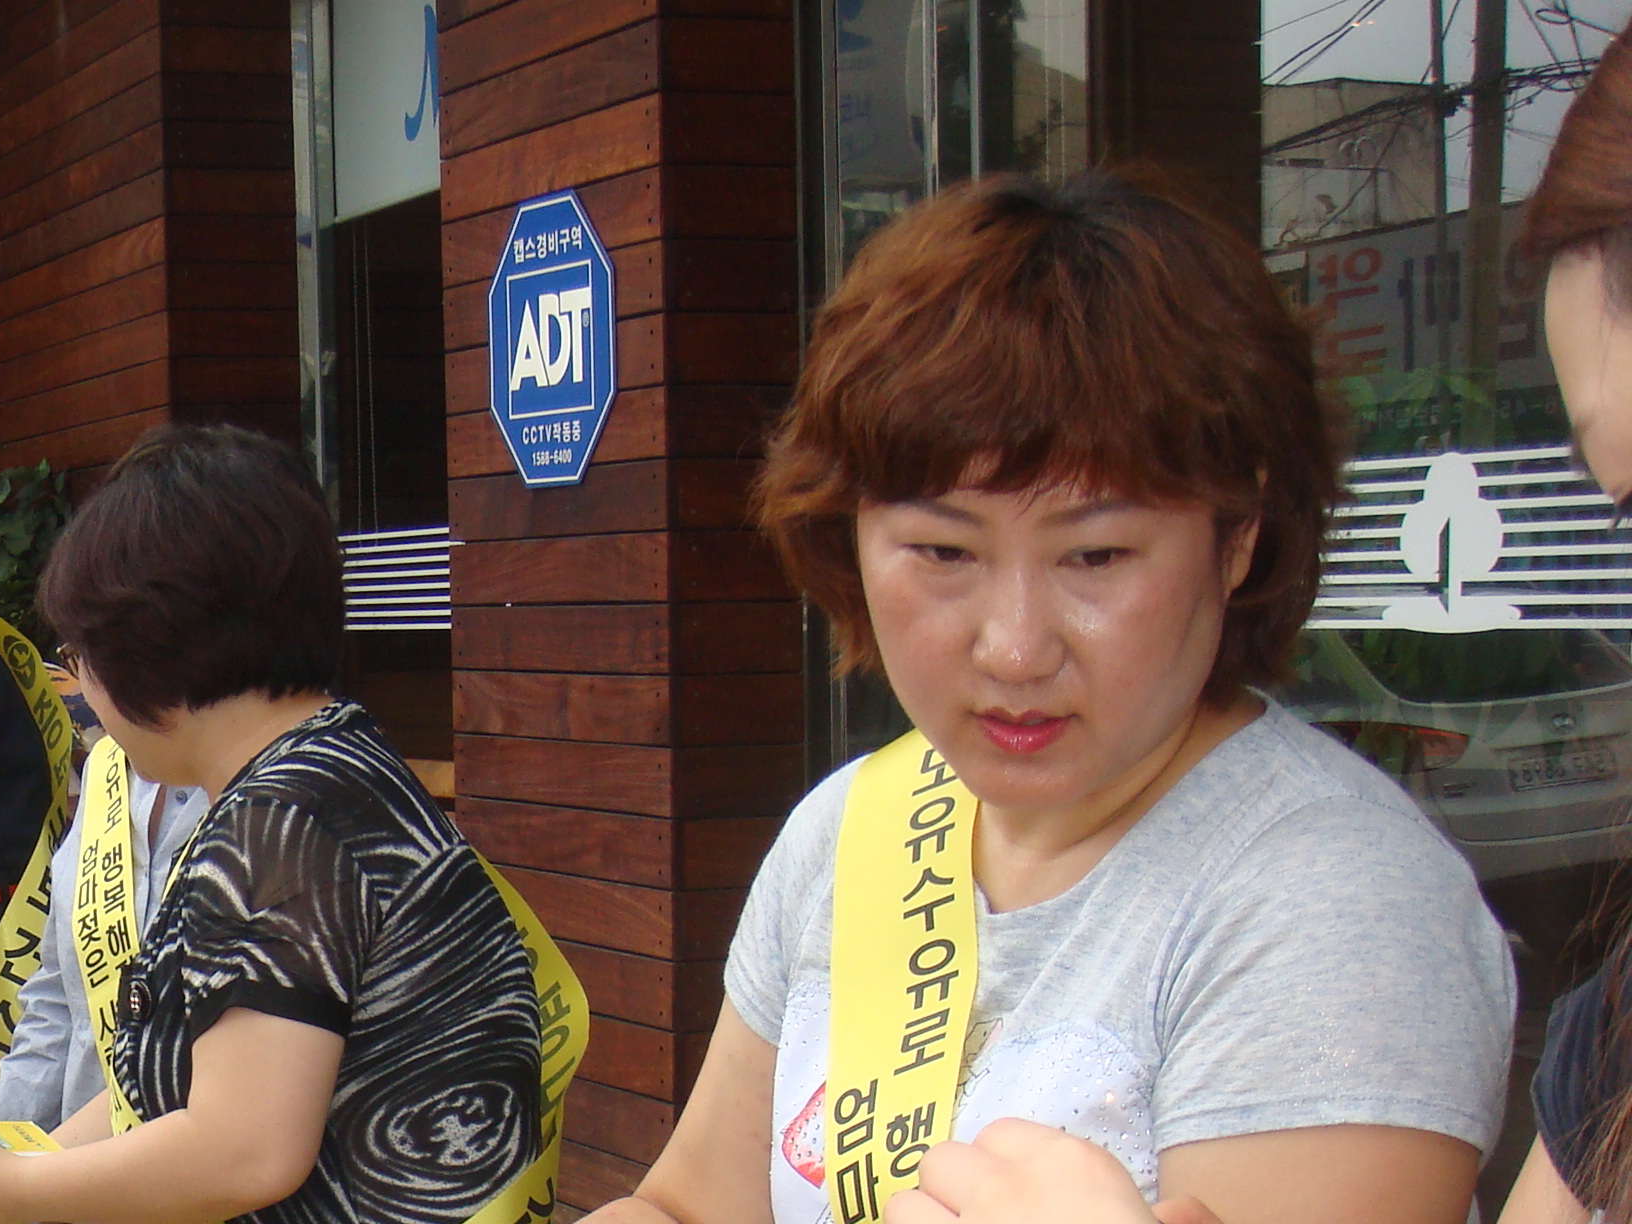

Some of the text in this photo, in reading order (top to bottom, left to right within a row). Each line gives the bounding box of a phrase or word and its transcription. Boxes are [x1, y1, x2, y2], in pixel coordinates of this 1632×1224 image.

[513, 224, 582, 264] 캡스경비구역
[511, 287, 591, 391] ADT
[522, 419, 582, 446] CCTV작동중
[531, 447, 572, 467] 1588-6400
